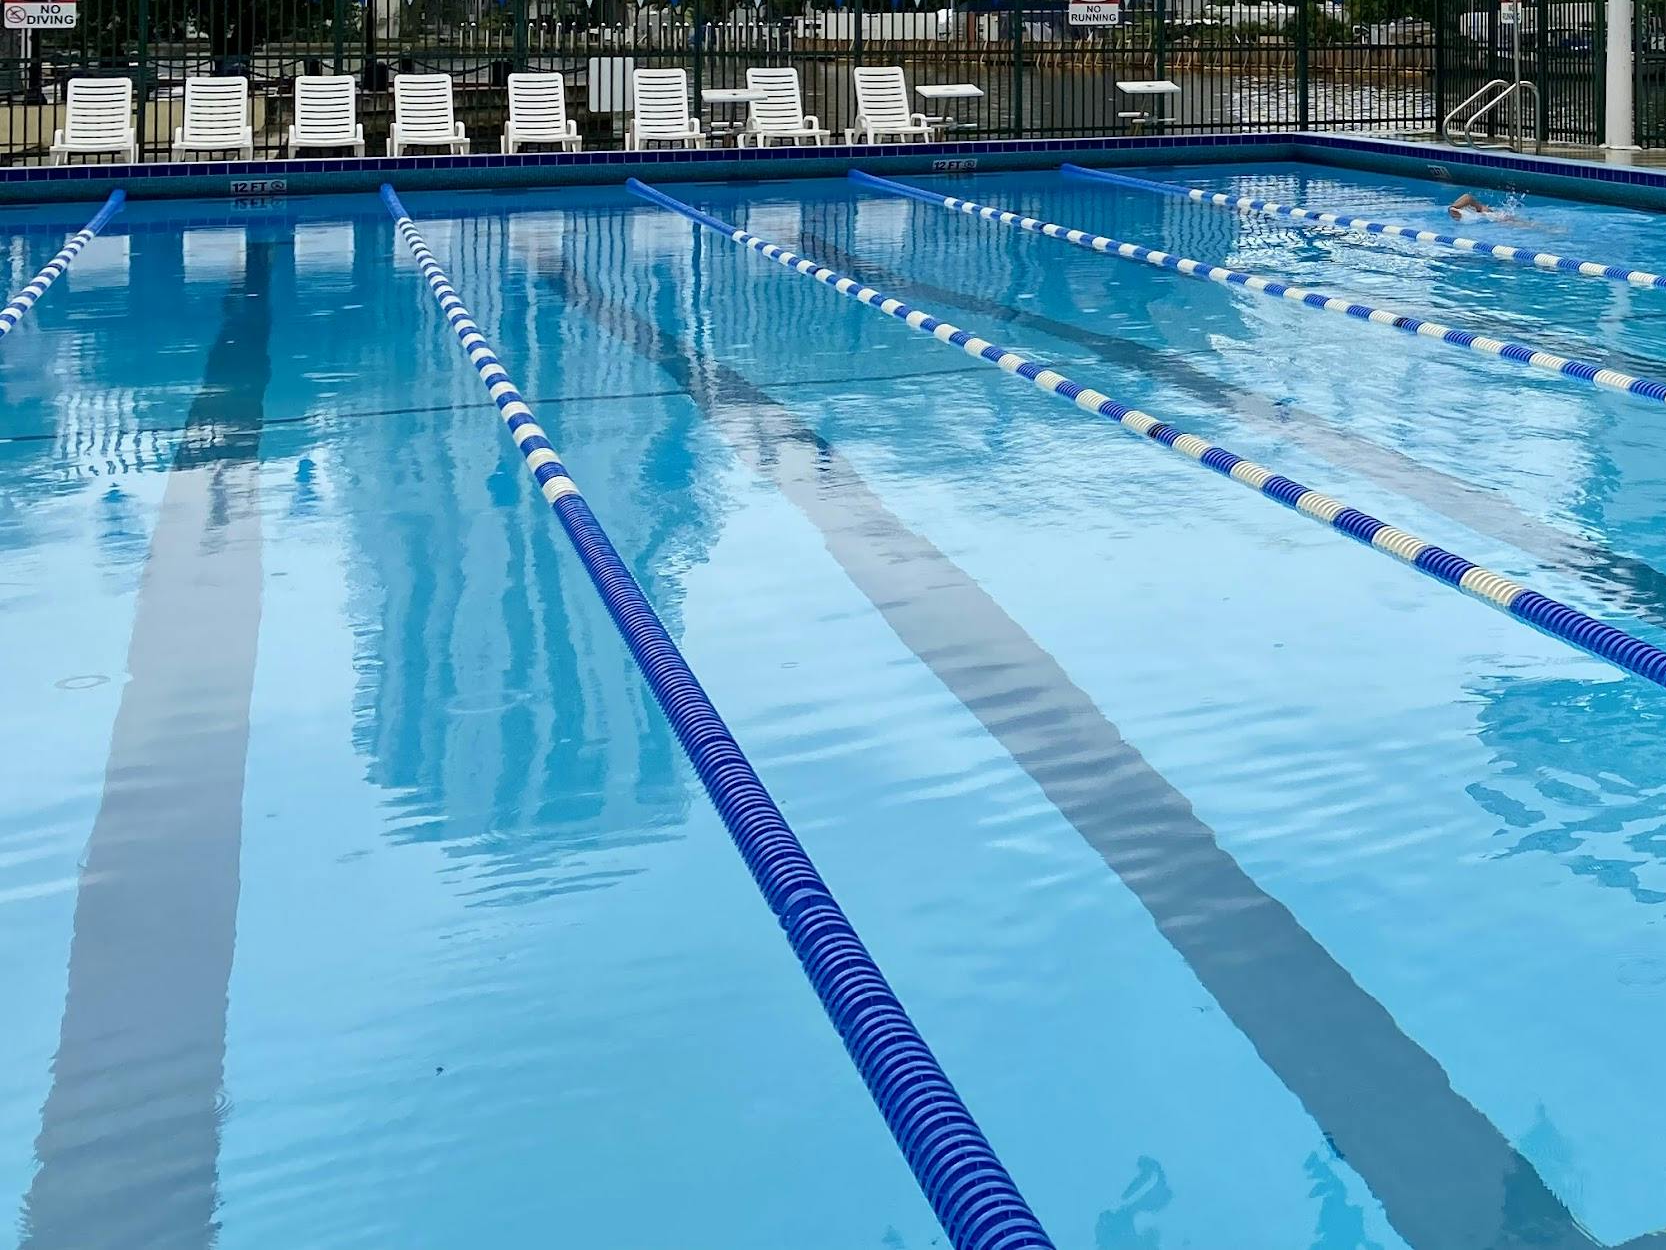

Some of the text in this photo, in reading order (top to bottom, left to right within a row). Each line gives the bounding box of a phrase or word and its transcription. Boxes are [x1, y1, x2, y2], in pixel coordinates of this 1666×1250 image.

[40, 4, 61, 14] NO
[1086, 5, 1101, 14] NO
[26, 15, 74, 25] DIVING
[1071, 13, 1117, 22] RUNNING
[947, 160, 962, 170] FT
[232, 181, 268, 193] 12 FT
